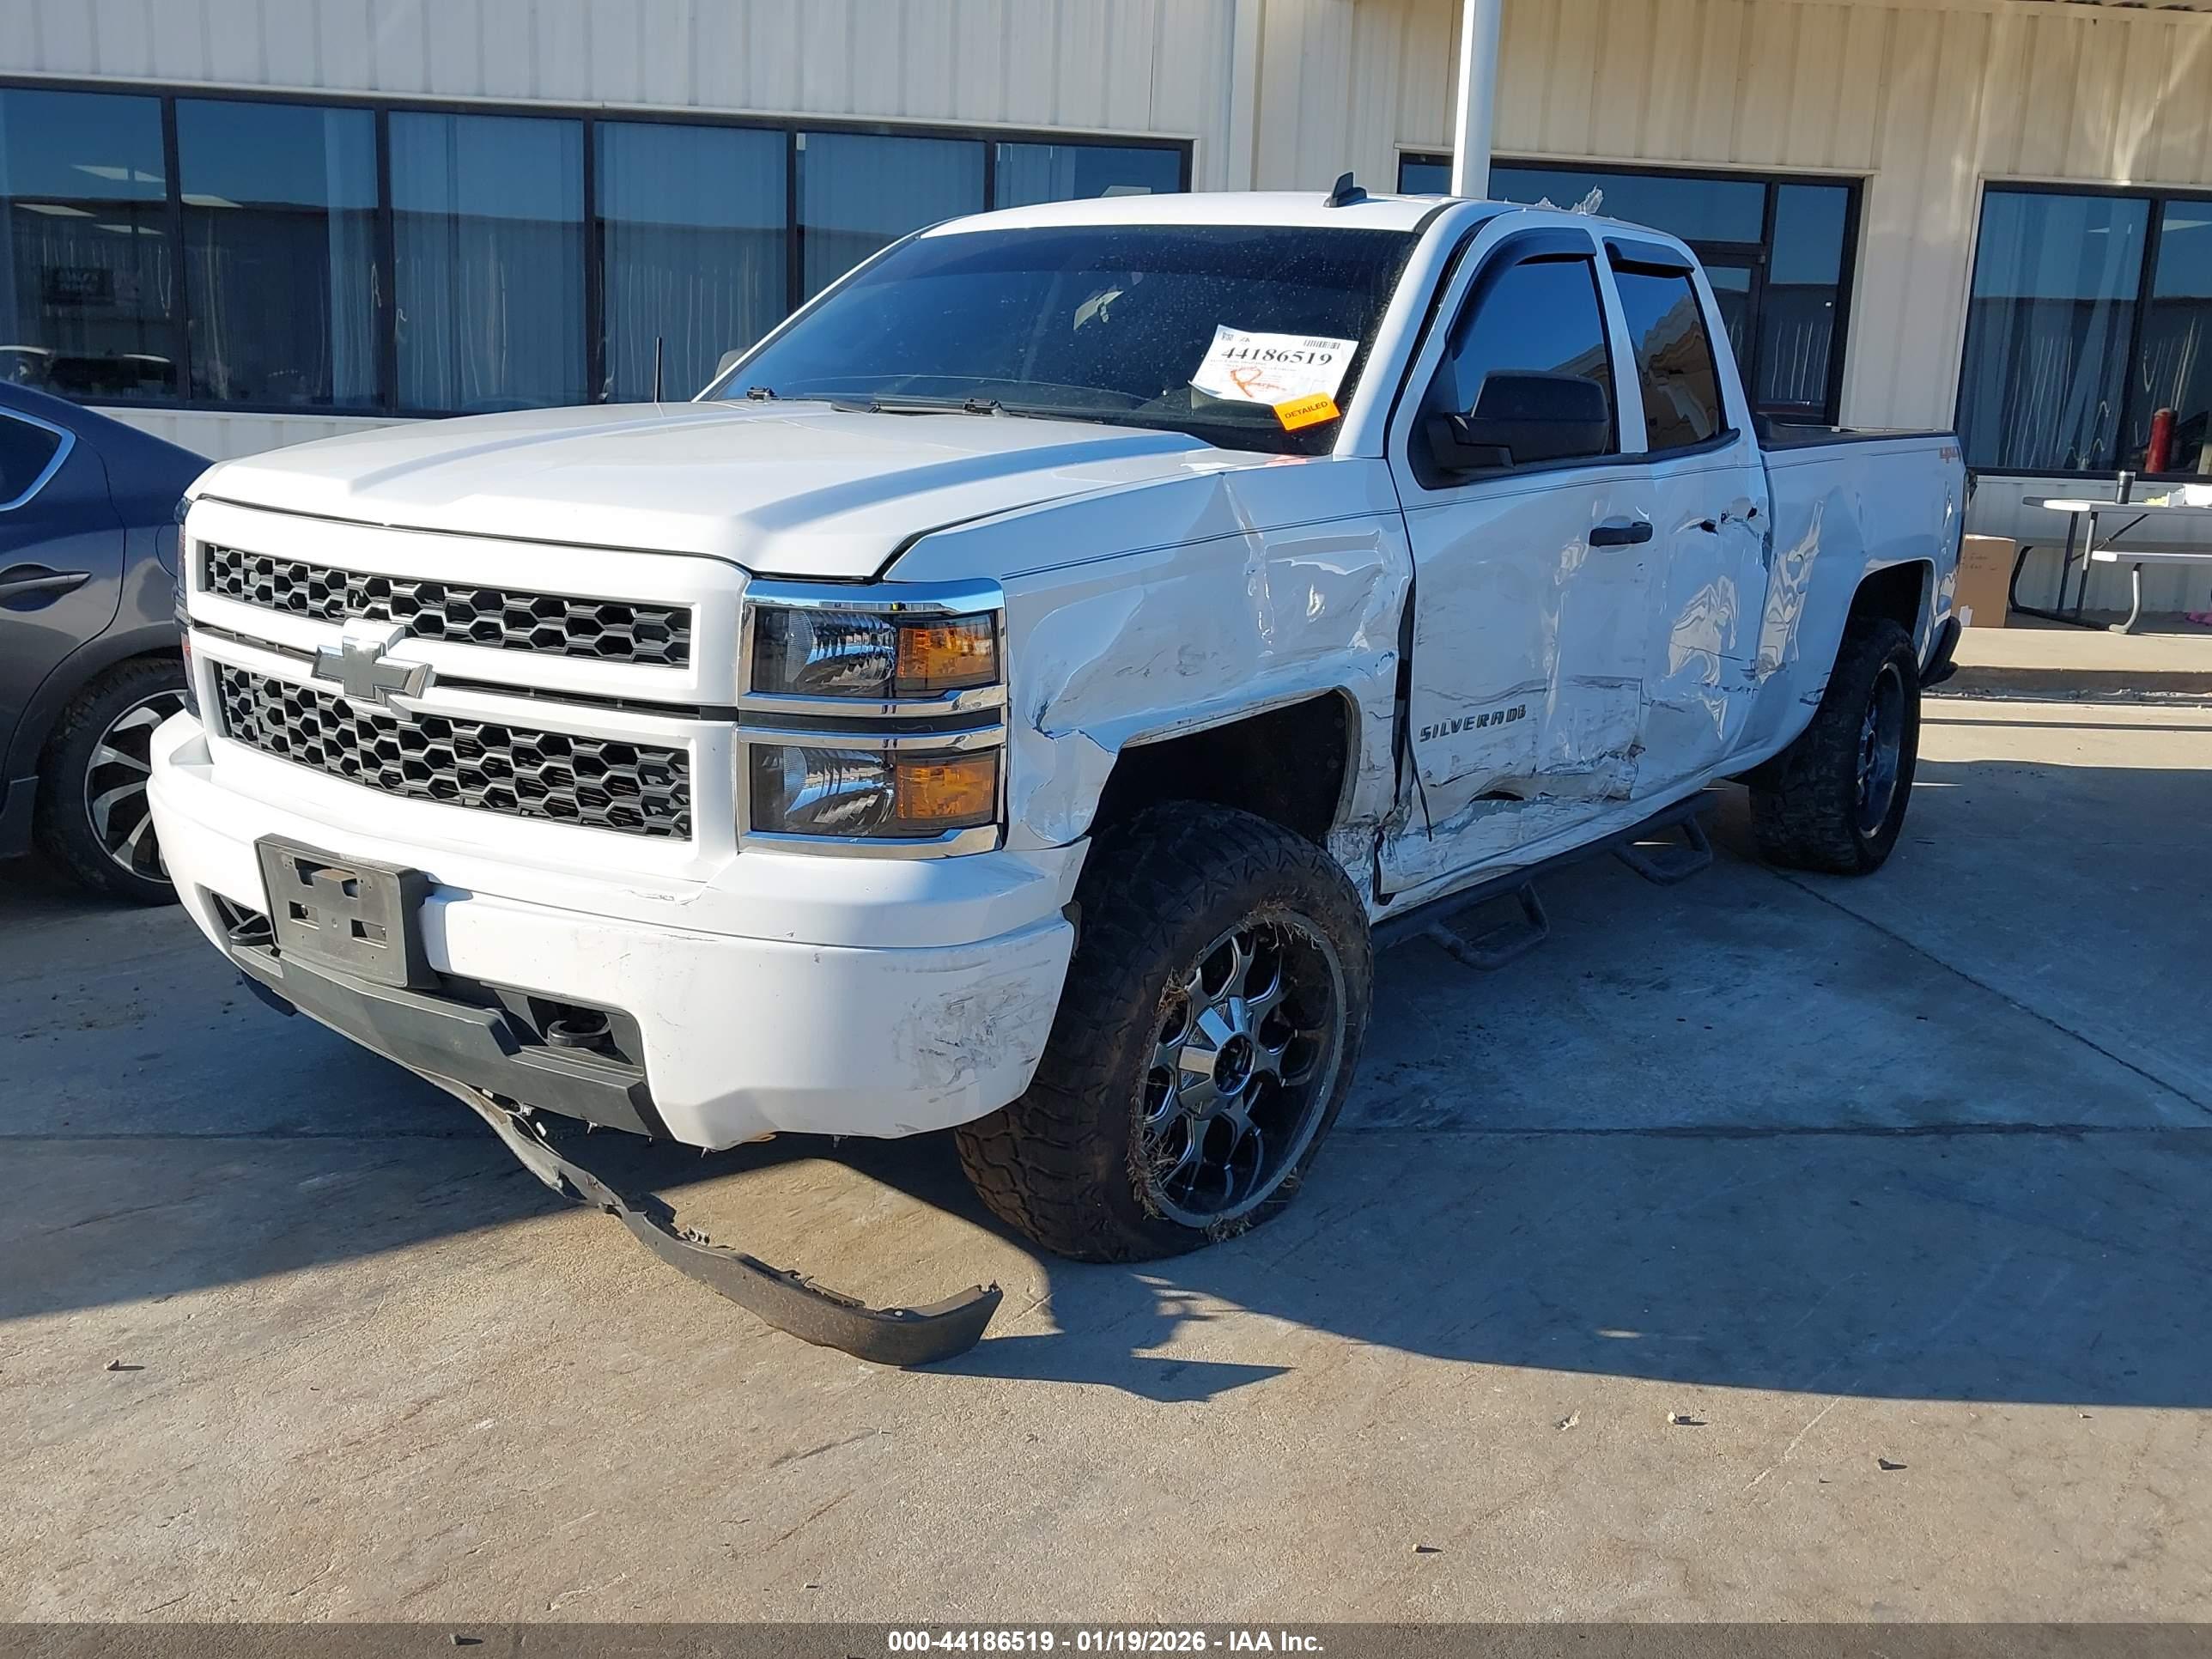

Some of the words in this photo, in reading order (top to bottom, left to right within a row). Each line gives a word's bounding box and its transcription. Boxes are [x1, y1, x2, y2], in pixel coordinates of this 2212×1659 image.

[1221, 346, 1334, 366] 44186519
[1285, 400, 1328, 420] DETAILED
[1419, 704, 1527, 743] SILVERADO
